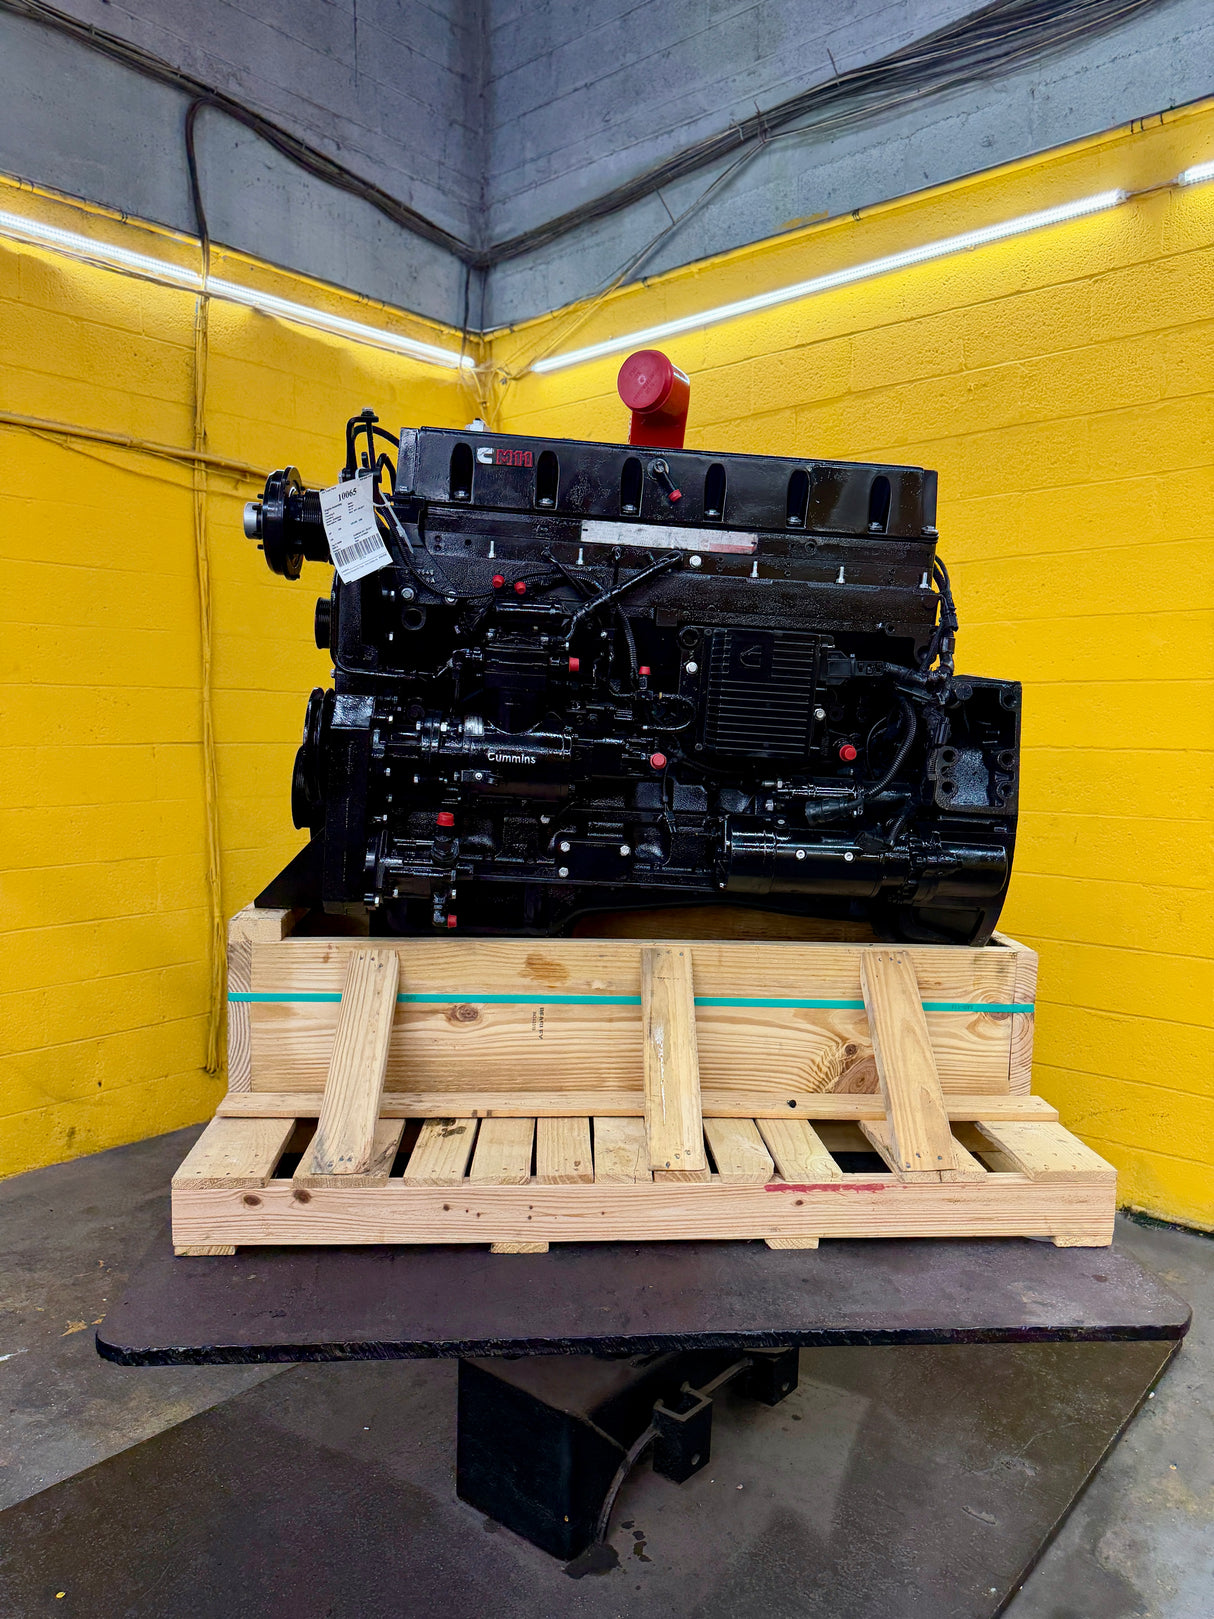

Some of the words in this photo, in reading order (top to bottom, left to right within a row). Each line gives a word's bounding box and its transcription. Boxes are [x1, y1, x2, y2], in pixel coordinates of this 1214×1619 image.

[496, 449, 533, 467] M11
[338, 487, 357, 502] 10065
[487, 752, 536, 764] Cummins
